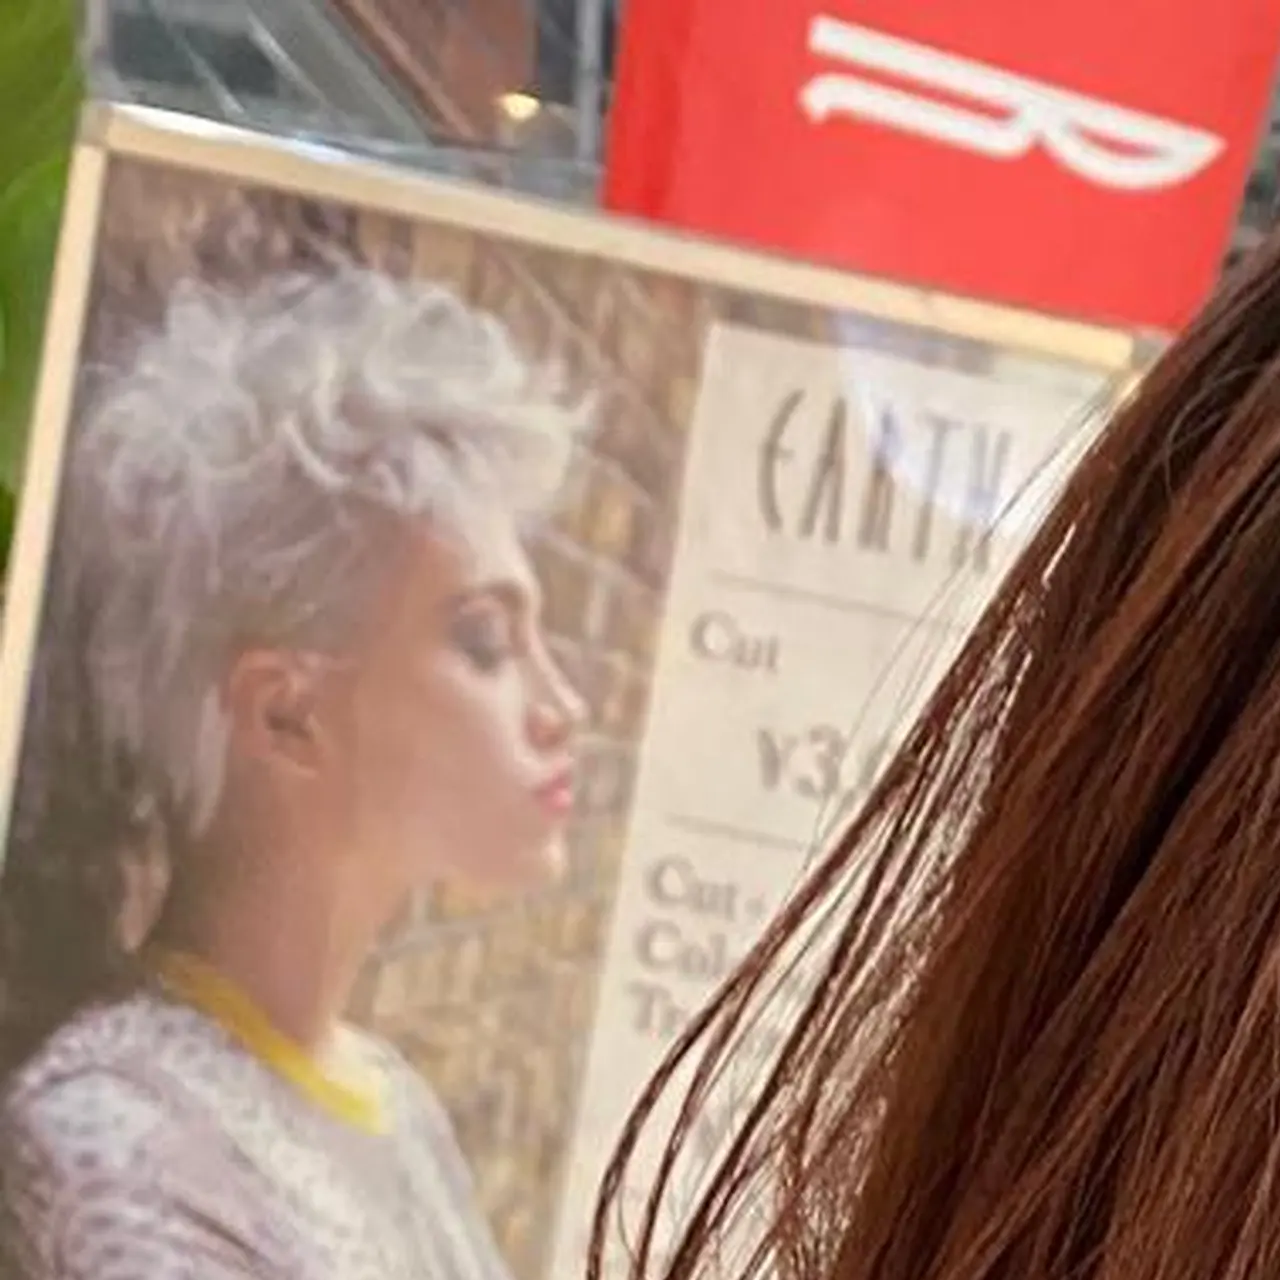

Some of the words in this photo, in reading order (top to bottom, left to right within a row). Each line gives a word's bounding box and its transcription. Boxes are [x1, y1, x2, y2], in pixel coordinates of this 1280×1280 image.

[757, 388, 1014, 574] EARTH
[690, 610, 780, 675] Cut
[645, 854, 738, 922] Cut
[633, 917, 742, 980] Col
